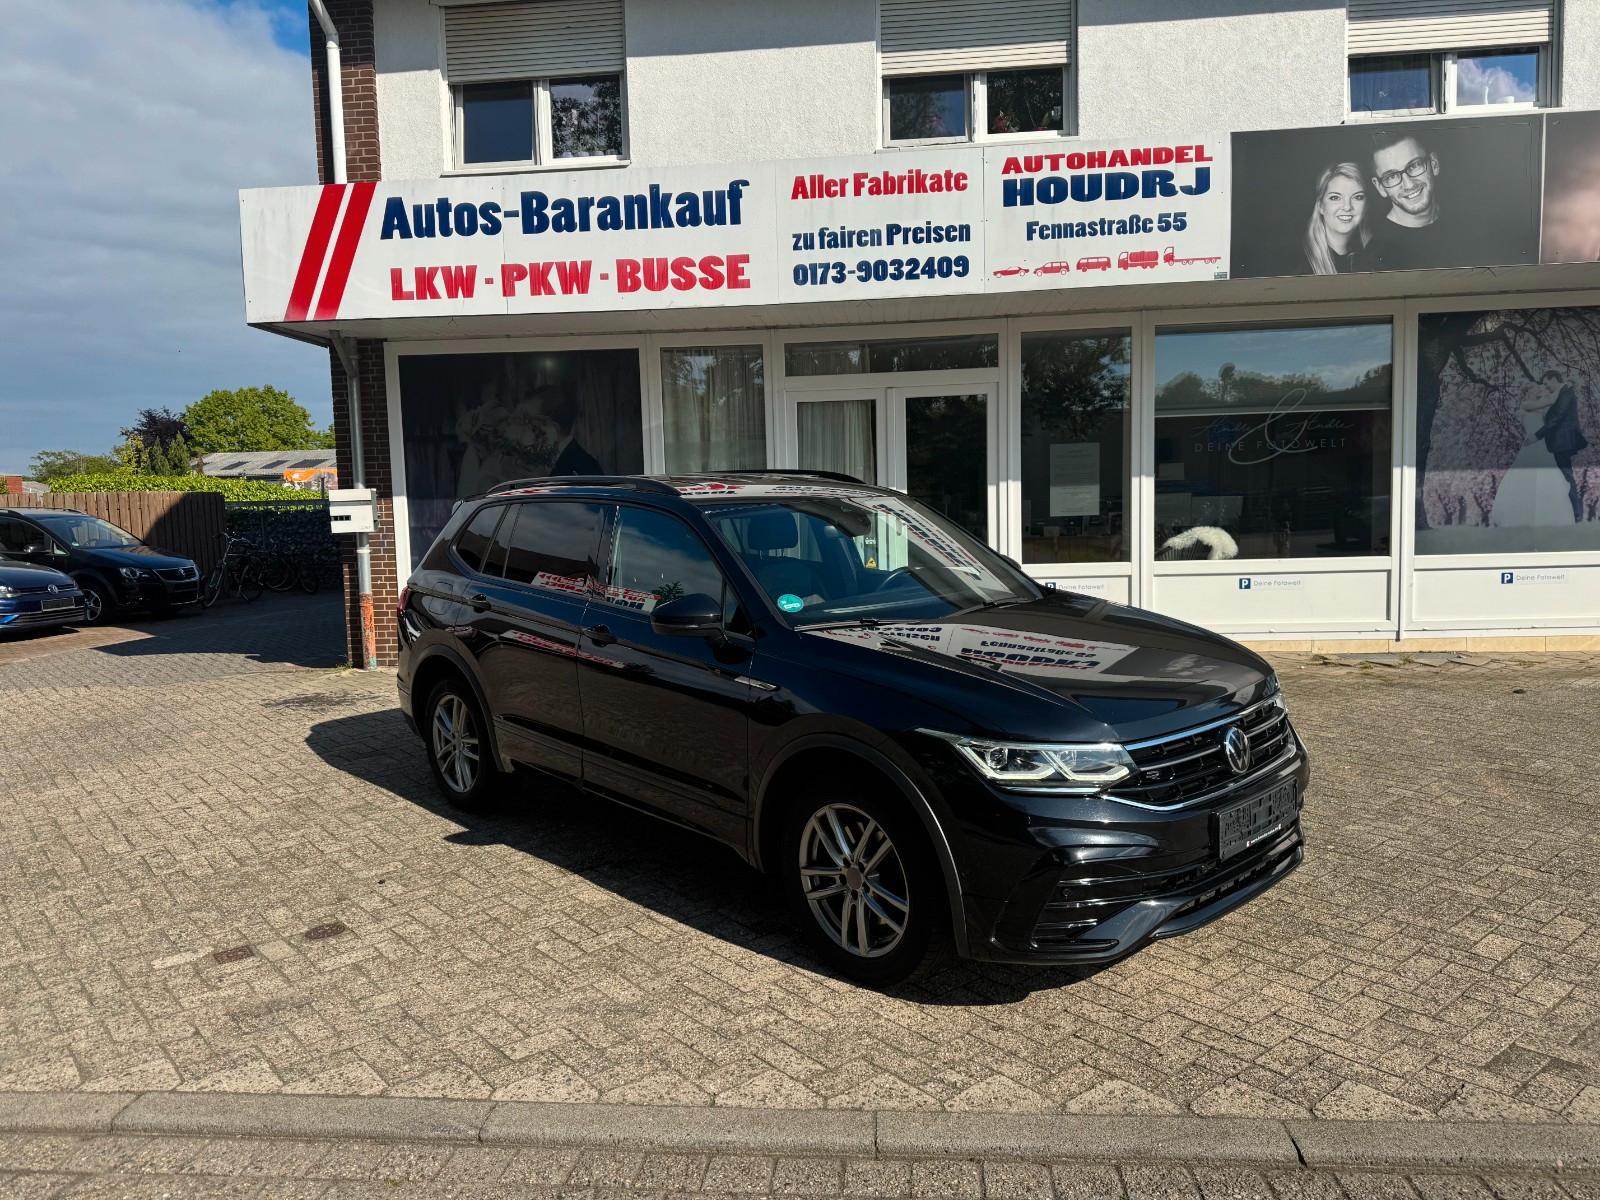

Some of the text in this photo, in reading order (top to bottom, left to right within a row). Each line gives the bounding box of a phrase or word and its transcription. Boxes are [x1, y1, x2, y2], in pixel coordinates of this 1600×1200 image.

[1001, 144, 1214, 175] AUTOHANDEL
[790, 169, 968, 201] Aller Fabrikate
[1002, 166, 1212, 208] HOUDRJ
[380, 179, 750, 240] Autos-Barankauf
[792, 221, 971, 251] zu fairen Preisen
[1026, 212, 1188, 241] Fennastraße 55
[390, 264, 478, 301] LKW
[500, 260, 593, 298] PKW
[615, 254, 751, 294] BUSSE
[793, 255, 970, 286] 0173-9032409
[1194, 437, 1346, 453] DEINE FOTOWELT
